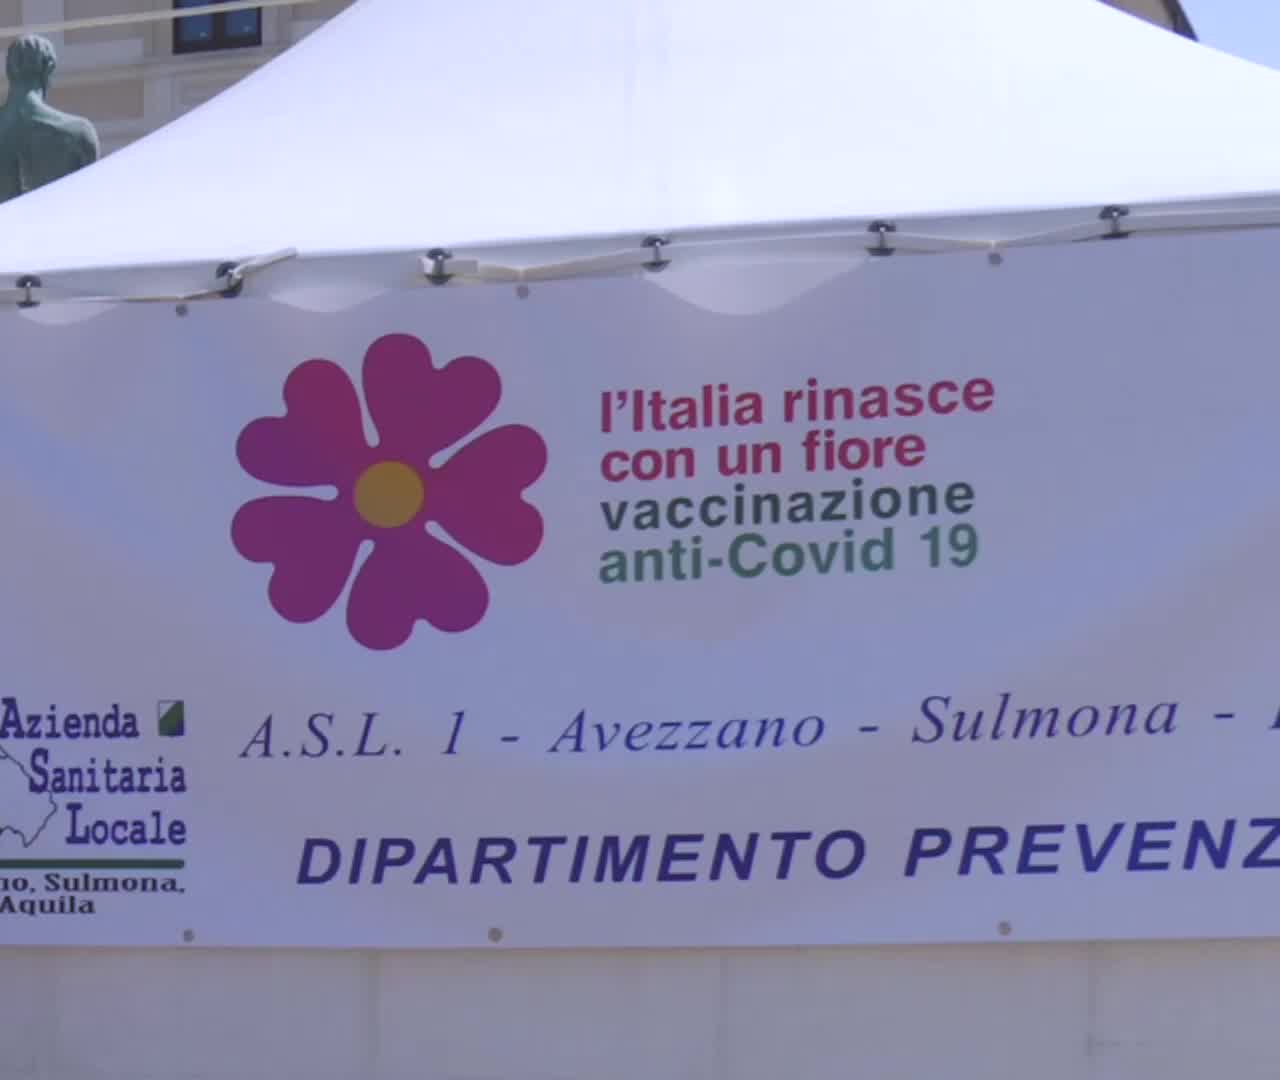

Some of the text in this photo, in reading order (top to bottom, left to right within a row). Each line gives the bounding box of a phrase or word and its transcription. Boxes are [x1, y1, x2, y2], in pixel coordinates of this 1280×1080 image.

[783, 377, 995, 423] rinasce
[600, 428, 927, 483] con un fiore
[600, 477, 976, 531] vaccinazione
[599, 522, 978, 584] anti-Covid 19
[239, 712, 401, 758] A.S.L.
[441, 710, 466, 756] 1
[548, 709, 825, 753] Avezzano
[911, 692, 1178, 744] Sulmona
[26, 747, 187, 795] Sanitaria
[65, 802, 187, 846] Locale
[44, 872, 185, 893] Sulmona,
[296, 829, 866, 885] DIPARTIMENTO
